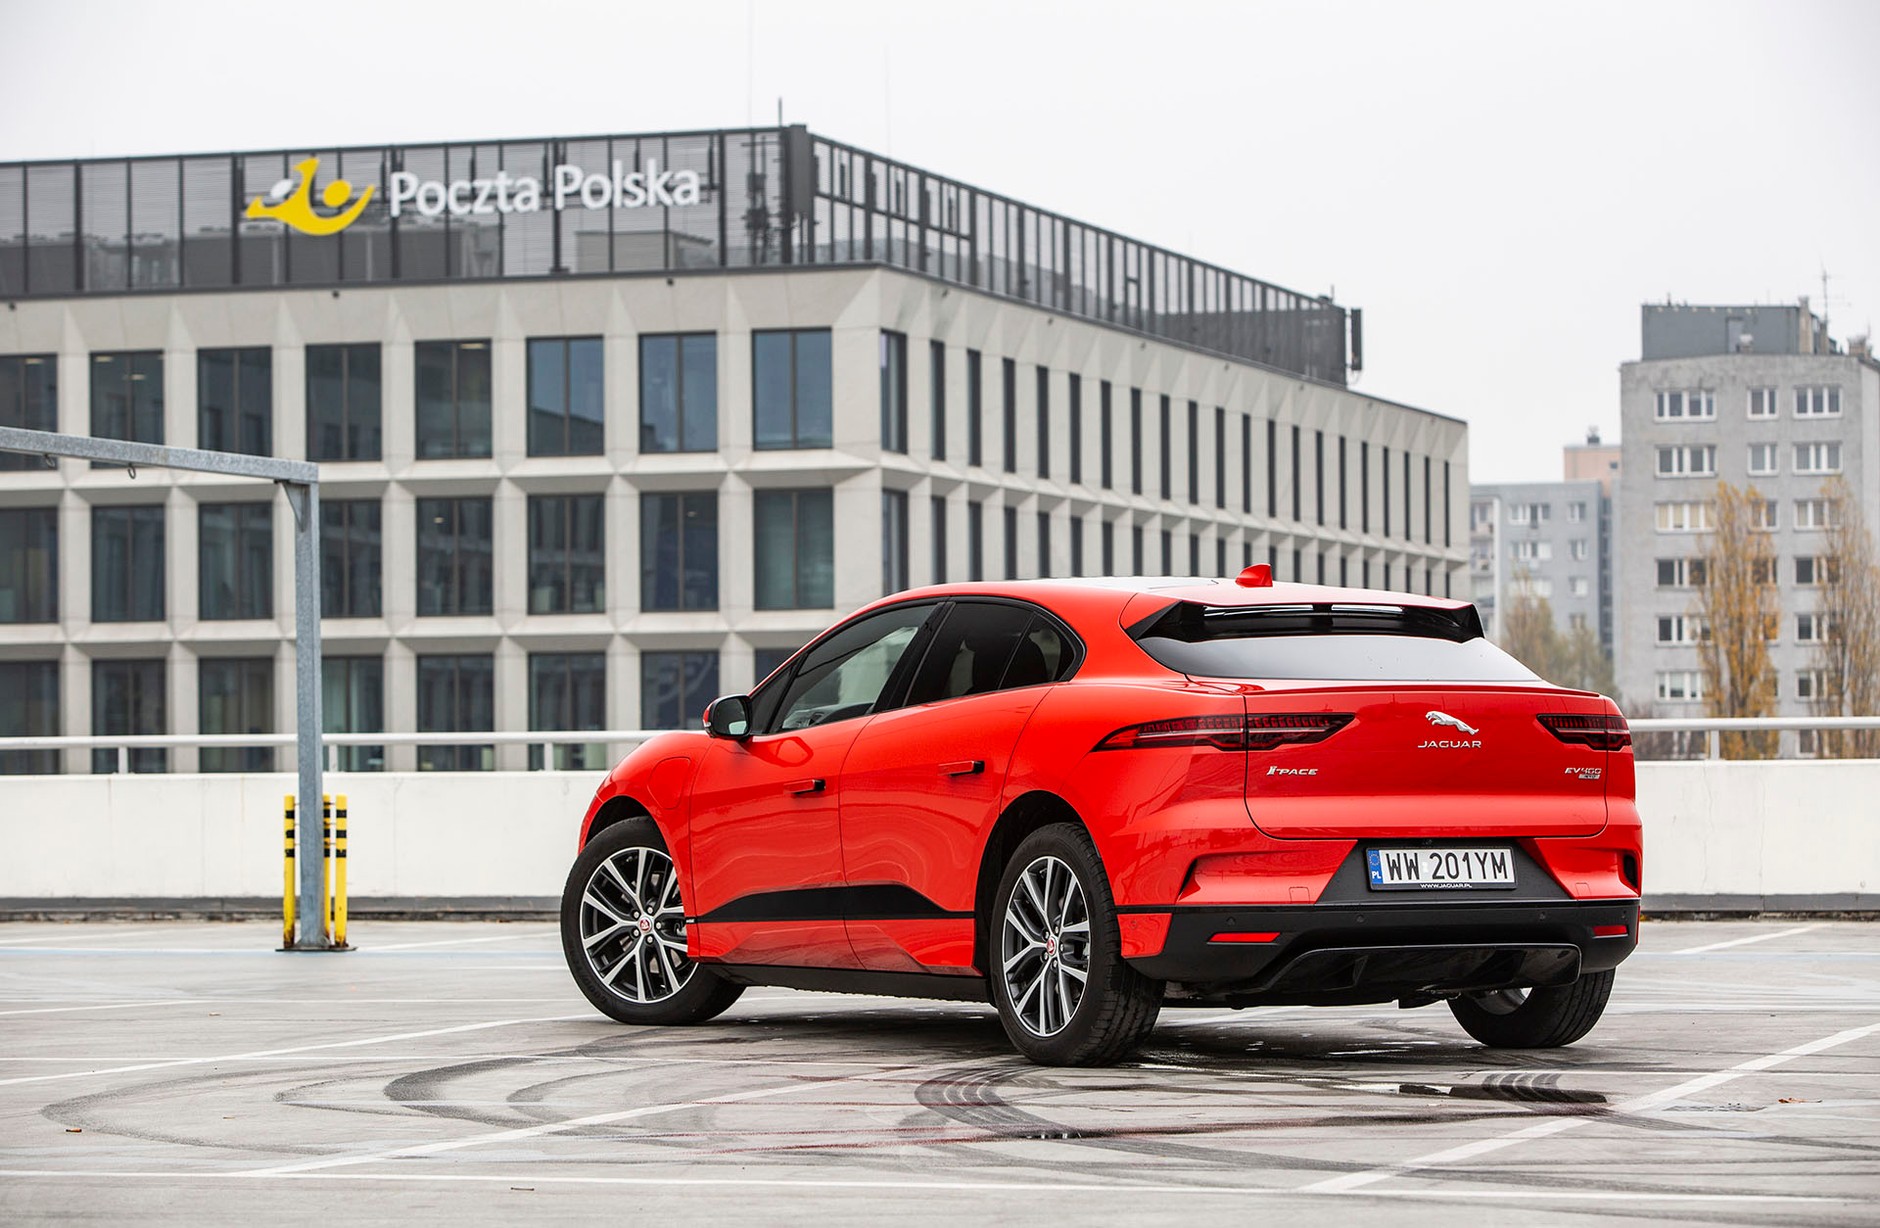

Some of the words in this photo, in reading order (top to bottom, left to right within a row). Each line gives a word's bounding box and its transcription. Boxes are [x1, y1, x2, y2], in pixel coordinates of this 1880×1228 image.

[390, 170, 539, 217] Poczta
[555, 158, 700, 210] Polska
[1417, 740, 1482, 748] JAGUAR
[1371, 870, 1382, 879] PL
[1386, 852, 1421, 881] WW
[1429, 851, 1508, 881] 201YM
